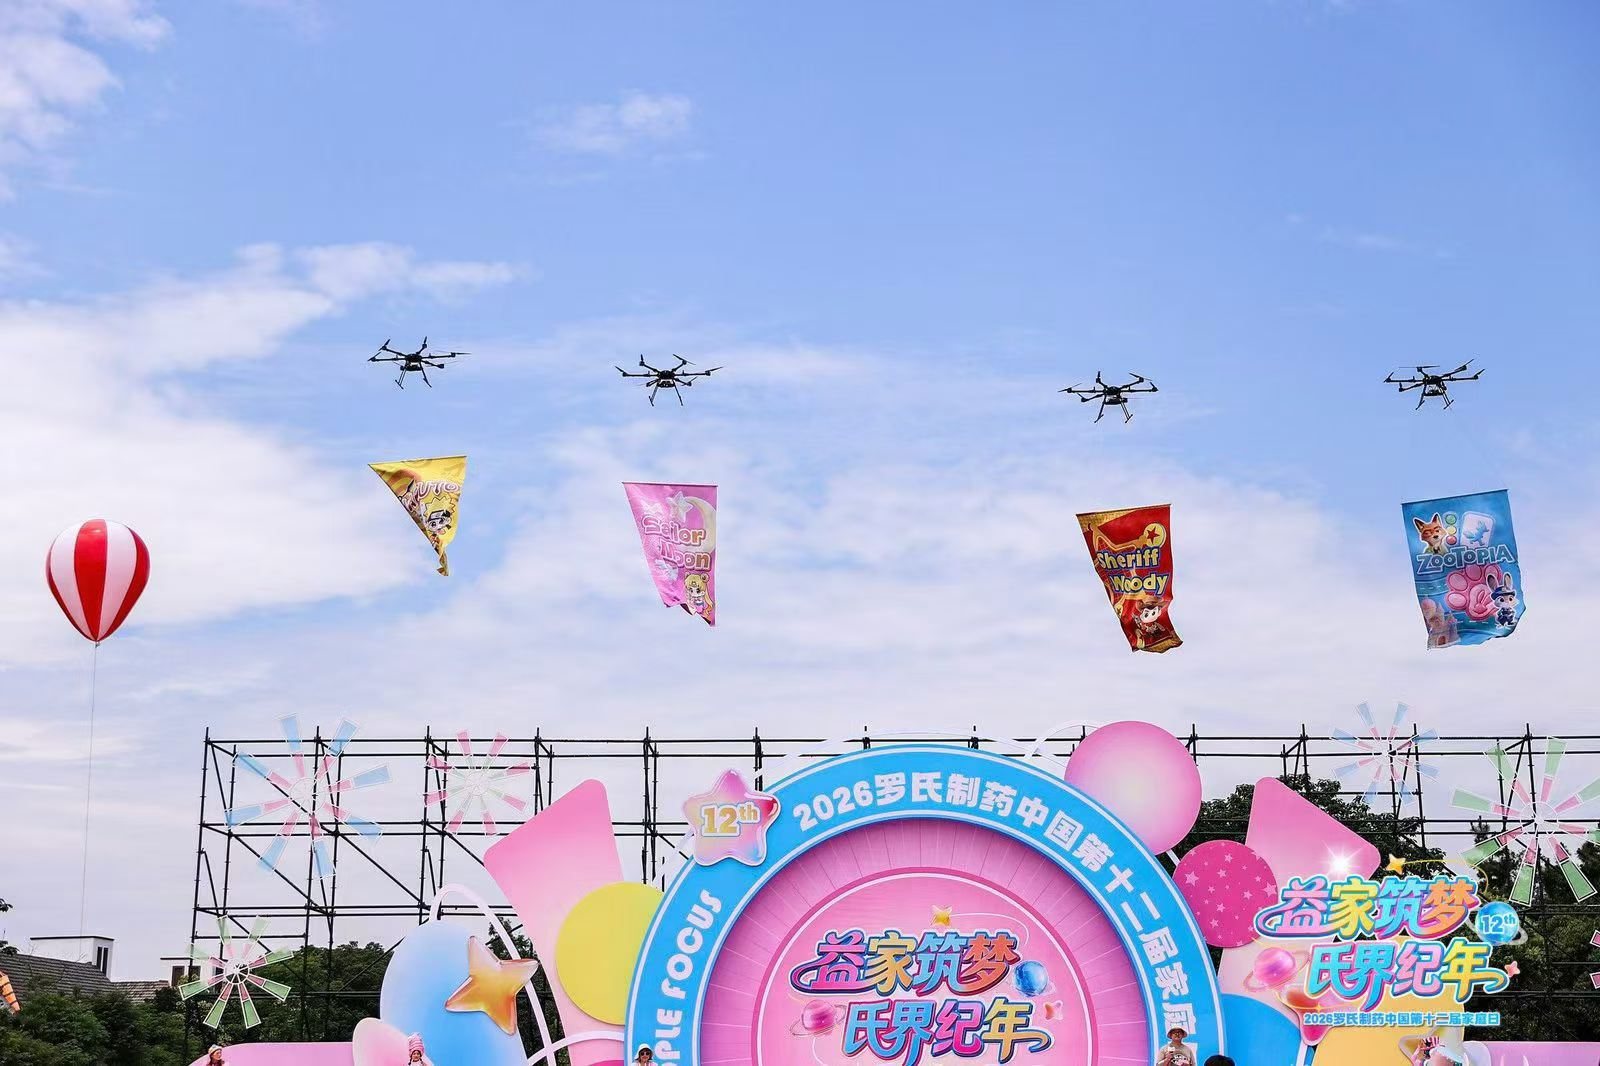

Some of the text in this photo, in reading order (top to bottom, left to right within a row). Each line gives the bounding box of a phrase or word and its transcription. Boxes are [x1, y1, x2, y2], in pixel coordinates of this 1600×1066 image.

[1096, 546, 1161, 571] Sheriff
[1109, 572, 1169, 595] Woody
[702, 802, 760, 837] 12th
[654, 889, 722, 1066] PLE FOCUS
[790, 929, 1022, 997] 益家筑梦
[841, 997, 1052, 1066] 氏界纪年
